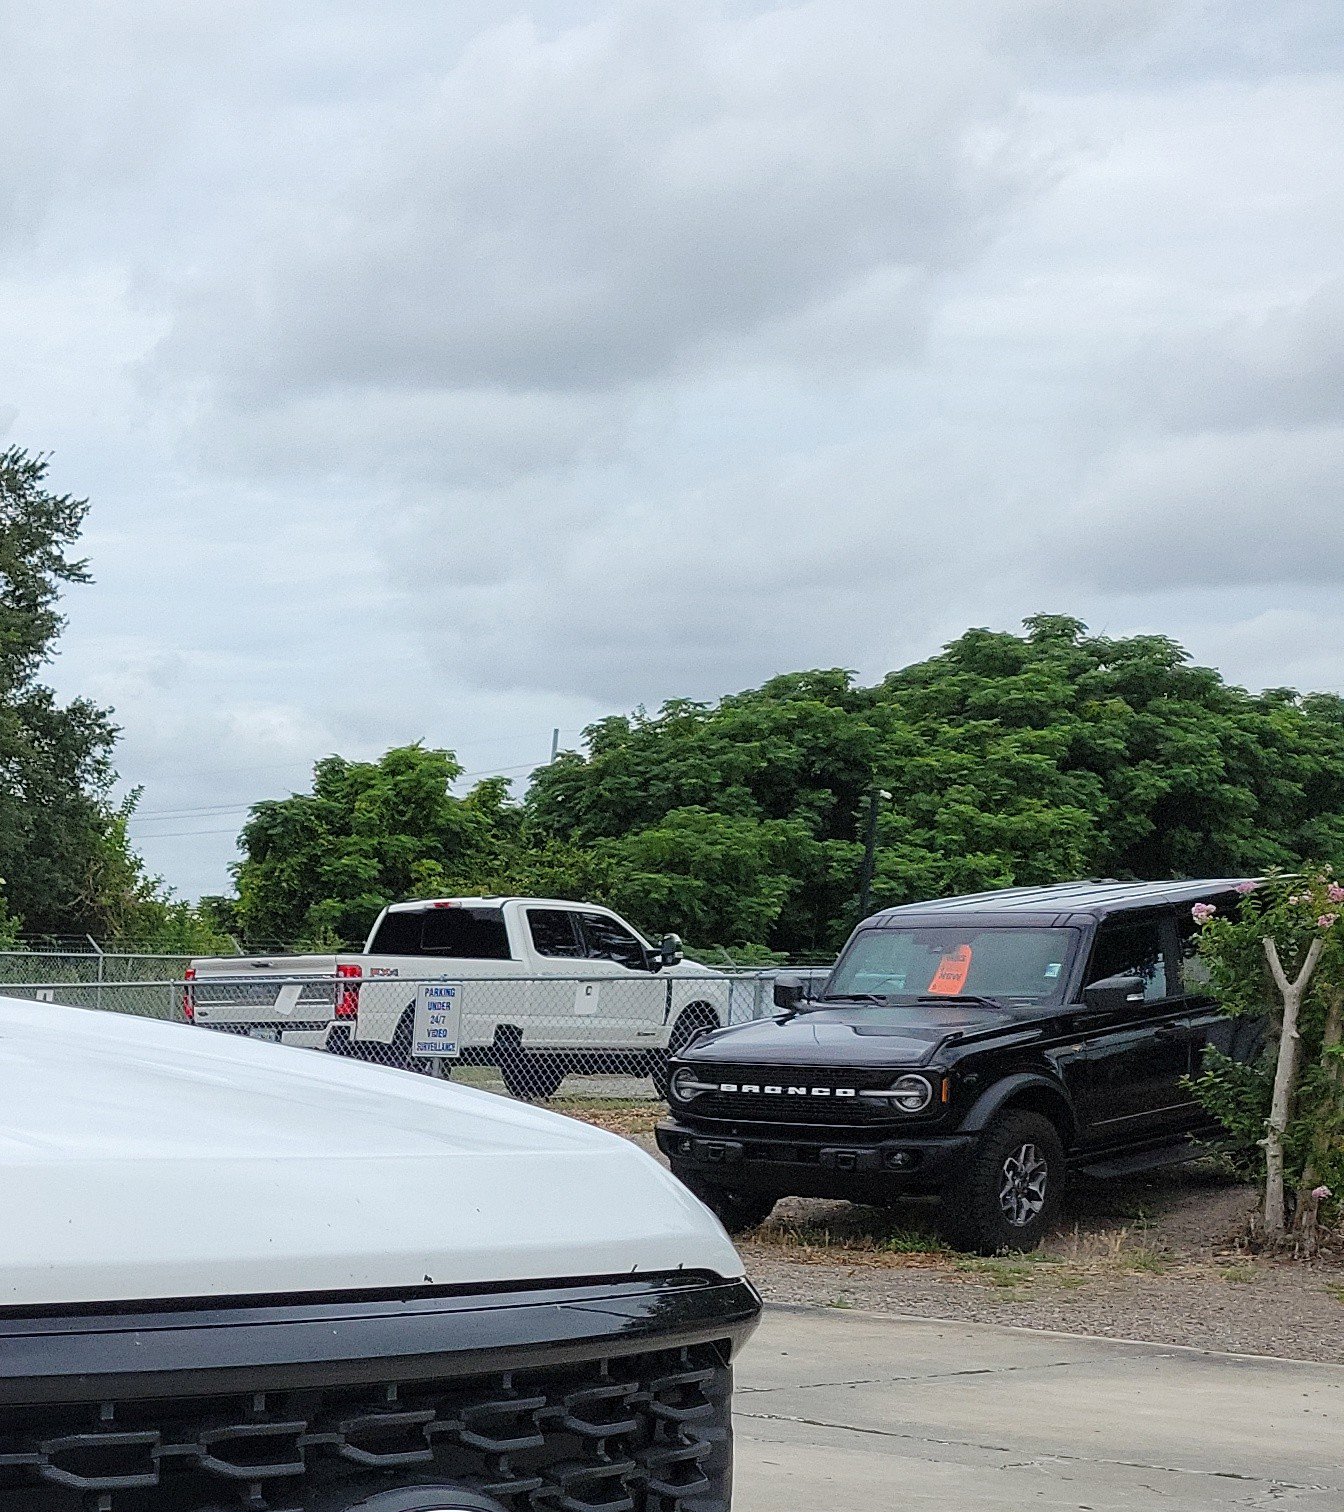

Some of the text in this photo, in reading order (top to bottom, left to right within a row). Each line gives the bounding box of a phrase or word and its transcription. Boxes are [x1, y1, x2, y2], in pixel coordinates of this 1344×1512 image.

[424, 987, 456, 997] PARKING
[427, 1001, 451, 1011] UNDER
[430, 1015, 446, 1025] 24/7
[426, 1028, 448, 1038] VIDEO
[416, 1041, 456, 1052] SURVEILLANCE
[720, 1083, 856, 1097] BRONCO
